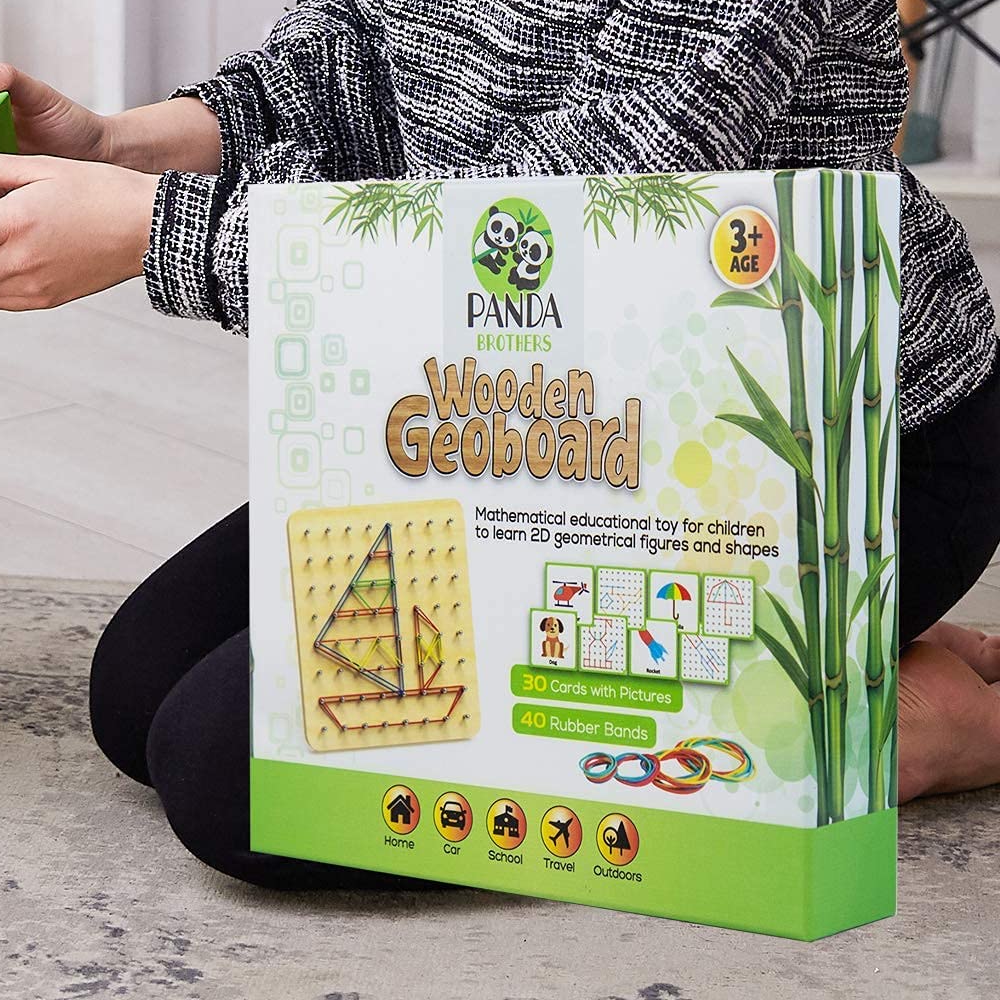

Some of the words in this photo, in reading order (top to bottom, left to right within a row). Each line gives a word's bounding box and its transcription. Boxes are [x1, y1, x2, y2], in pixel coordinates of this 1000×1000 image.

[729, 218, 763, 253] 3+
[729, 254, 760, 273] AGE
[467, 292, 563, 328] PANDA
[476, 333, 552, 352] BROTHERS
[423, 356, 595, 420] Wooden
[385, 394, 642, 490] Geoboard
[475, 507, 566, 525] Mathematical
[570, 514, 651, 530] educational
[655, 518, 679, 535] toy
[682, 518, 704, 533] for
[707, 520, 765, 537] children
[475, 526, 490, 539] to
[493, 525, 527, 542] learn
[531, 528, 551, 543] 2D
[554, 532, 637, 549] geometrical
[640, 535, 690, 555] figures
[693, 539, 721, 554] and
[725, 541, 780, 560] shapes
[522, 673, 548, 692] 30
[550, 679, 588, 696] Cards
[590, 684, 617, 699] with
[620, 686, 672, 704] Pictures
[520, 711, 547, 729] 40
[550, 716, 601, 735] Rubber
[604, 721, 649, 741] Bands
[384, 835, 415, 850] Home
[443, 843, 461, 856] Car
[488, 850, 523, 865] School
[543, 857, 576, 873] Travel
[593, 864, 643, 883] Outdoors
